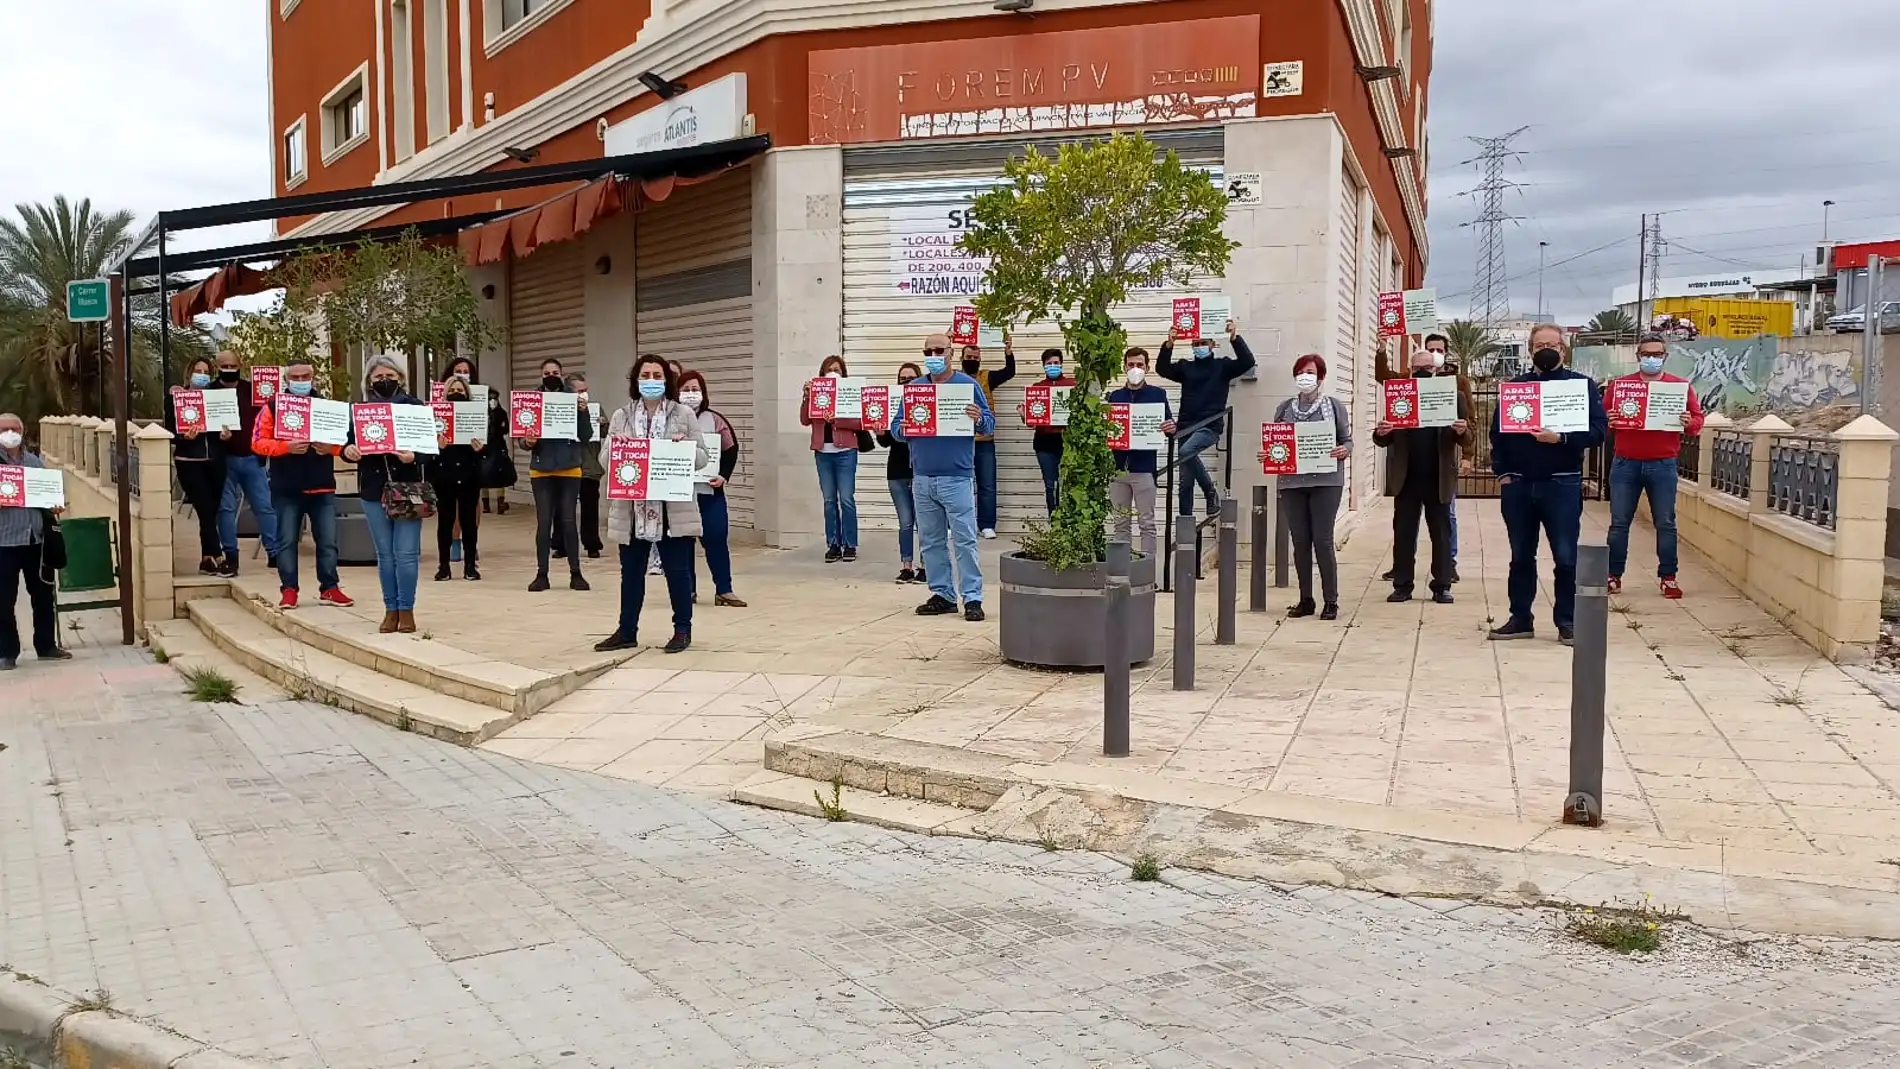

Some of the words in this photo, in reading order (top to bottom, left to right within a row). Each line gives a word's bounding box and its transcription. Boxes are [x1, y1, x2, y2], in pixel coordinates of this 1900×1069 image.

[898, 66, 1044, 103] FOREM
[1062, 61, 1109, 93] PV
[664, 115, 698, 143] ATLANTIS
[948, 209, 979, 229] SE
[908, 235, 949, 246] LOCAL
[908, 263, 925, 273] DE
[928, 262, 955, 272] 200,
[958, 262, 985, 271] 400,
[911, 273, 950, 294] RAZÓN
[952, 272, 980, 295] AQUÍ
[1525, 384, 1534, 394] SÍ
[1616, 390, 1625, 398] SÍ
[513, 399, 521, 408] SÍ
[862, 394, 870, 403] SÍ
[905, 394, 914, 404] SÍ
[1263, 432, 1272, 441] SÍ
[612, 449, 622, 460] SÍ
